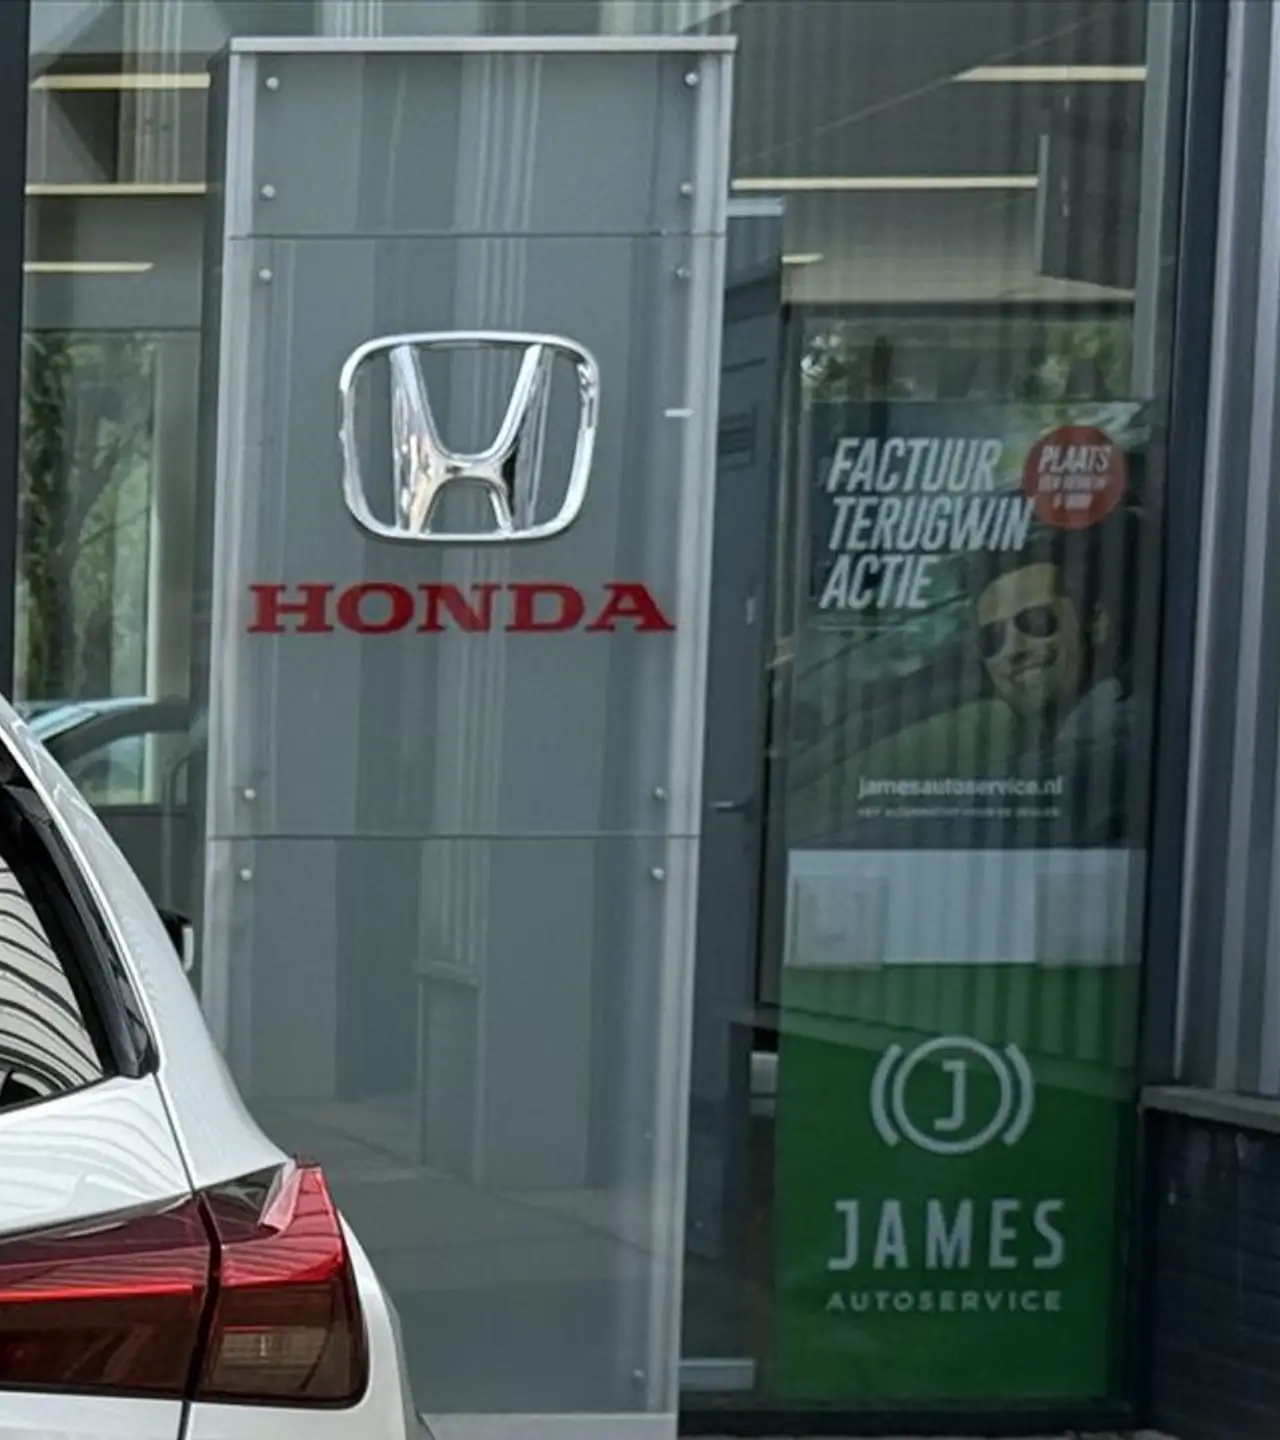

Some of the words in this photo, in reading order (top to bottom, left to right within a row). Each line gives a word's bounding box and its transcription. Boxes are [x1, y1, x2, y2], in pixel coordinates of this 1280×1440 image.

[828, 436, 1003, 493] FACTUUR
[828, 497, 1037, 553] TERUGWIN
[246, 582, 676, 634] HONDA
[819, 553, 936, 609] ACTIE
[857, 776, 1064, 799] jamesautoservice.nl
[827, 1199, 1065, 1271] JAMES
[826, 1289, 1063, 1312] AUTOSERVICE
